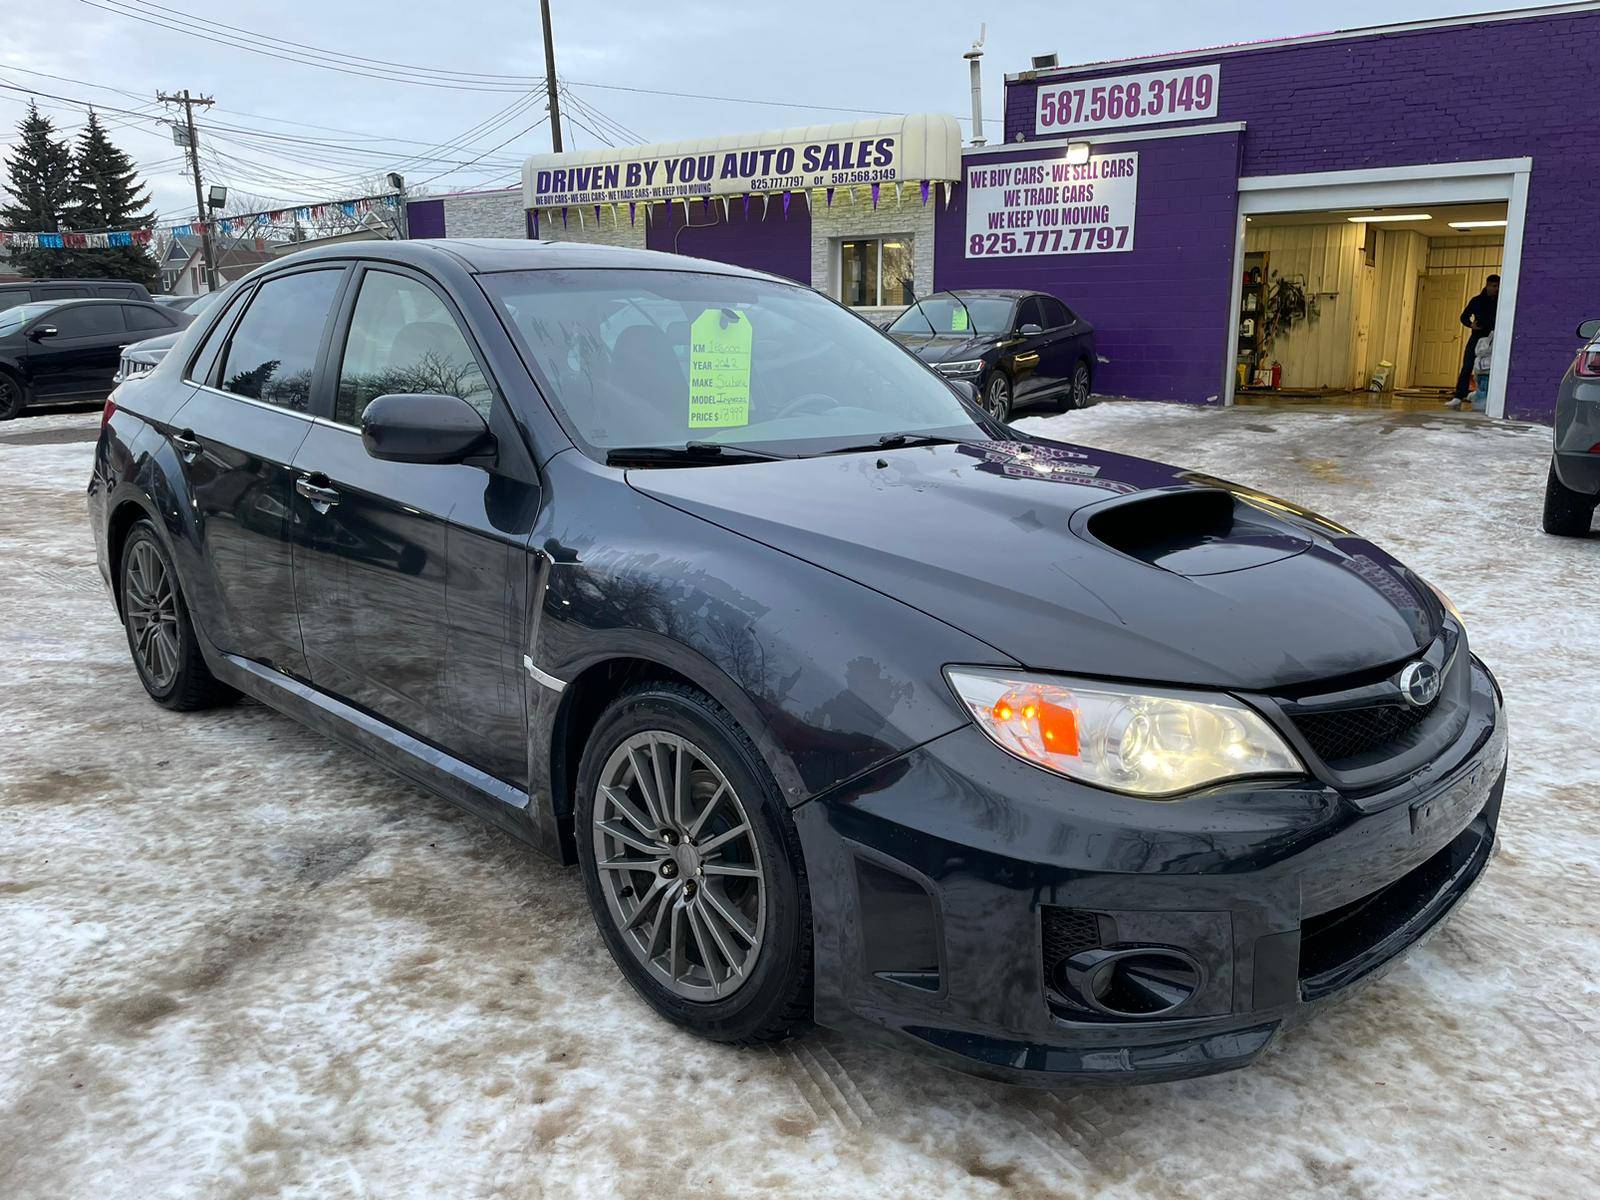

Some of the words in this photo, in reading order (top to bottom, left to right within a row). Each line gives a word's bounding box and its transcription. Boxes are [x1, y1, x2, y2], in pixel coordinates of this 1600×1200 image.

[1041, 74, 1212, 127] 587.568.3149
[536, 164, 620, 194] DRIVEN
[625, 161, 659, 189] BY
[664, 155, 715, 184] YOU
[720, 147, 796, 179] AUTO
[802, 138, 895, 174] SALES
[970, 170, 988, 189] WE
[989, 168, 1012, 188] BUY
[1013, 166, 1045, 186] CARS
[1052, 163, 1071, 182] WE
[1072, 161, 1099, 181] SELL
[1101, 157, 1134, 178] CARS
[750, 175, 805, 190] 825.777.7797
[814, 175, 824, 186] or
[832, 168, 896, 184] 587.568.3149
[535, 196, 544, 206] WE
[543, 195, 554, 205] BUY
[570, 193, 579, 203] WE
[579, 192, 591, 202] SELL
[608, 191, 617, 201] WE
[617, 189, 633, 200] TRADE
[652, 187, 662, 197] WE
[1004, 190, 1021, 207] WE
[1023, 186, 1059, 206] TRADE
[1062, 184, 1094, 203] CARS
[988, 211, 1005, 230] WE
[1007, 209, 1034, 228] KEEP
[1036, 208, 1059, 227] YOU
[1061, 205, 1110, 226] MOVING
[969, 226, 1129, 256] 825.777.7797
[693, 344, 705, 353] KM
[693, 361, 712, 370] YEAR
[692, 379, 713, 388] MAKE
[691, 395, 716, 404] MODEL
[691, 412, 714, 422] PRICE
